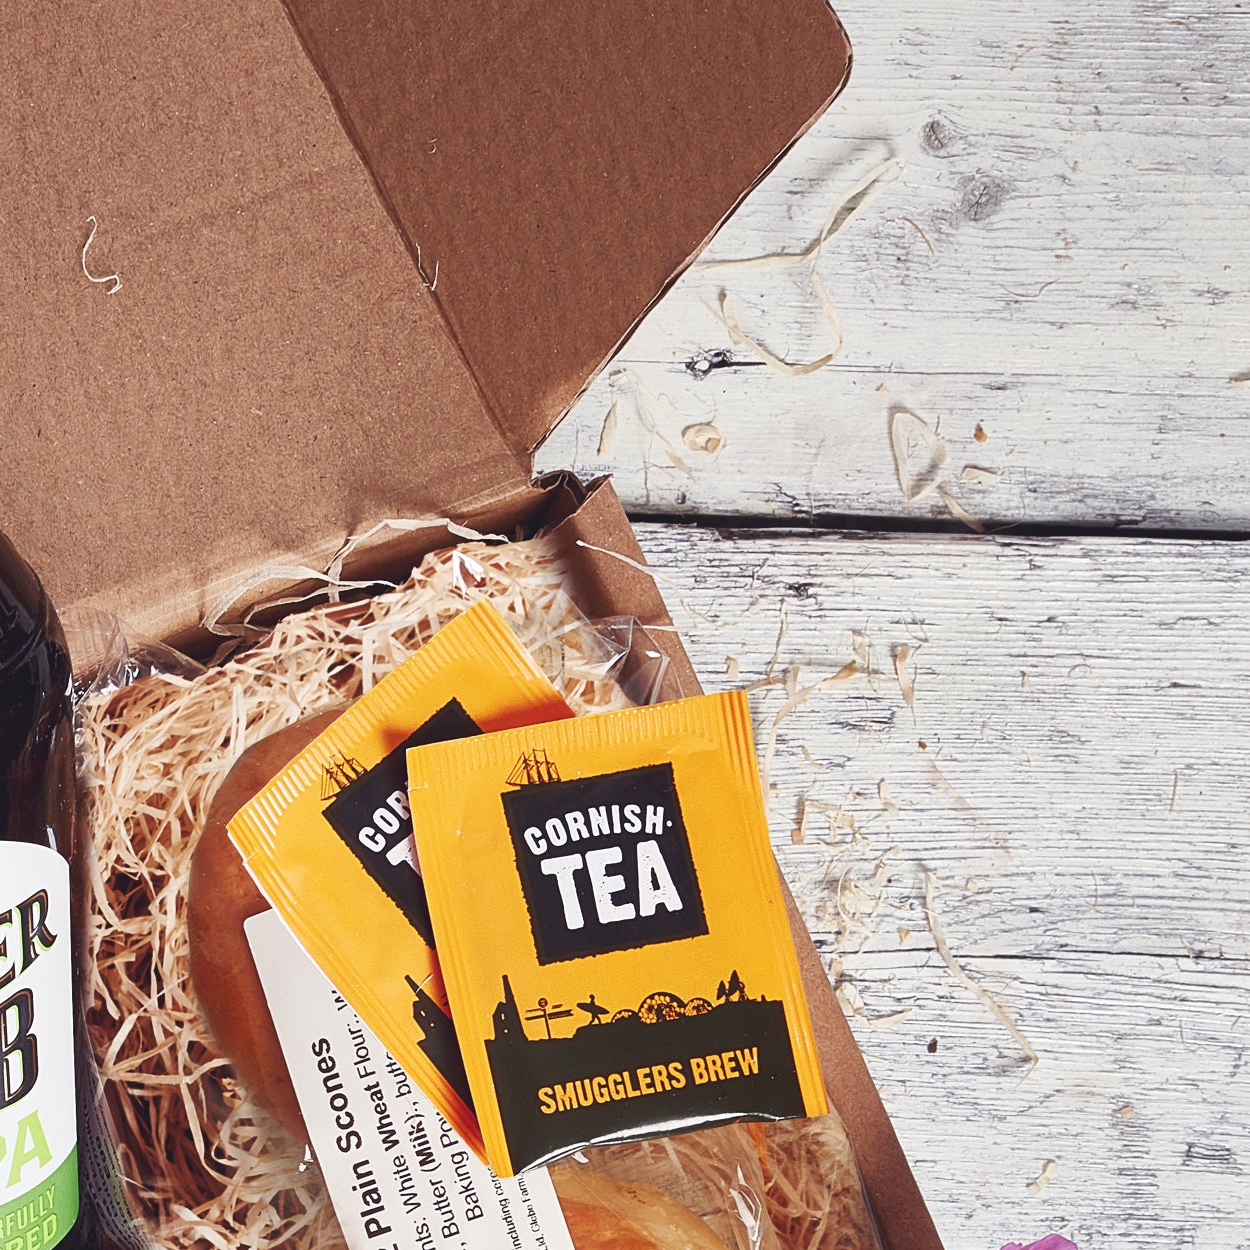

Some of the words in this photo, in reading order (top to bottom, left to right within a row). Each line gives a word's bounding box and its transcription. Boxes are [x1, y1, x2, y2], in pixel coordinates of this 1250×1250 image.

[541, 839, 683, 930] TEA
[312, 1037, 363, 1154] Scones
[538, 1062, 686, 1114] SMUGGLERS
[690, 1047, 759, 1085] BREW
[364, 1081, 400, 1152] Wheat
[352, 1159, 392, 1239] Plain
[393, 1155, 421, 1214] White
[430, 1178, 460, 1239] Butter
[451, 1151, 484, 1222] Baking
[500, 1199, 522, 1250] including
